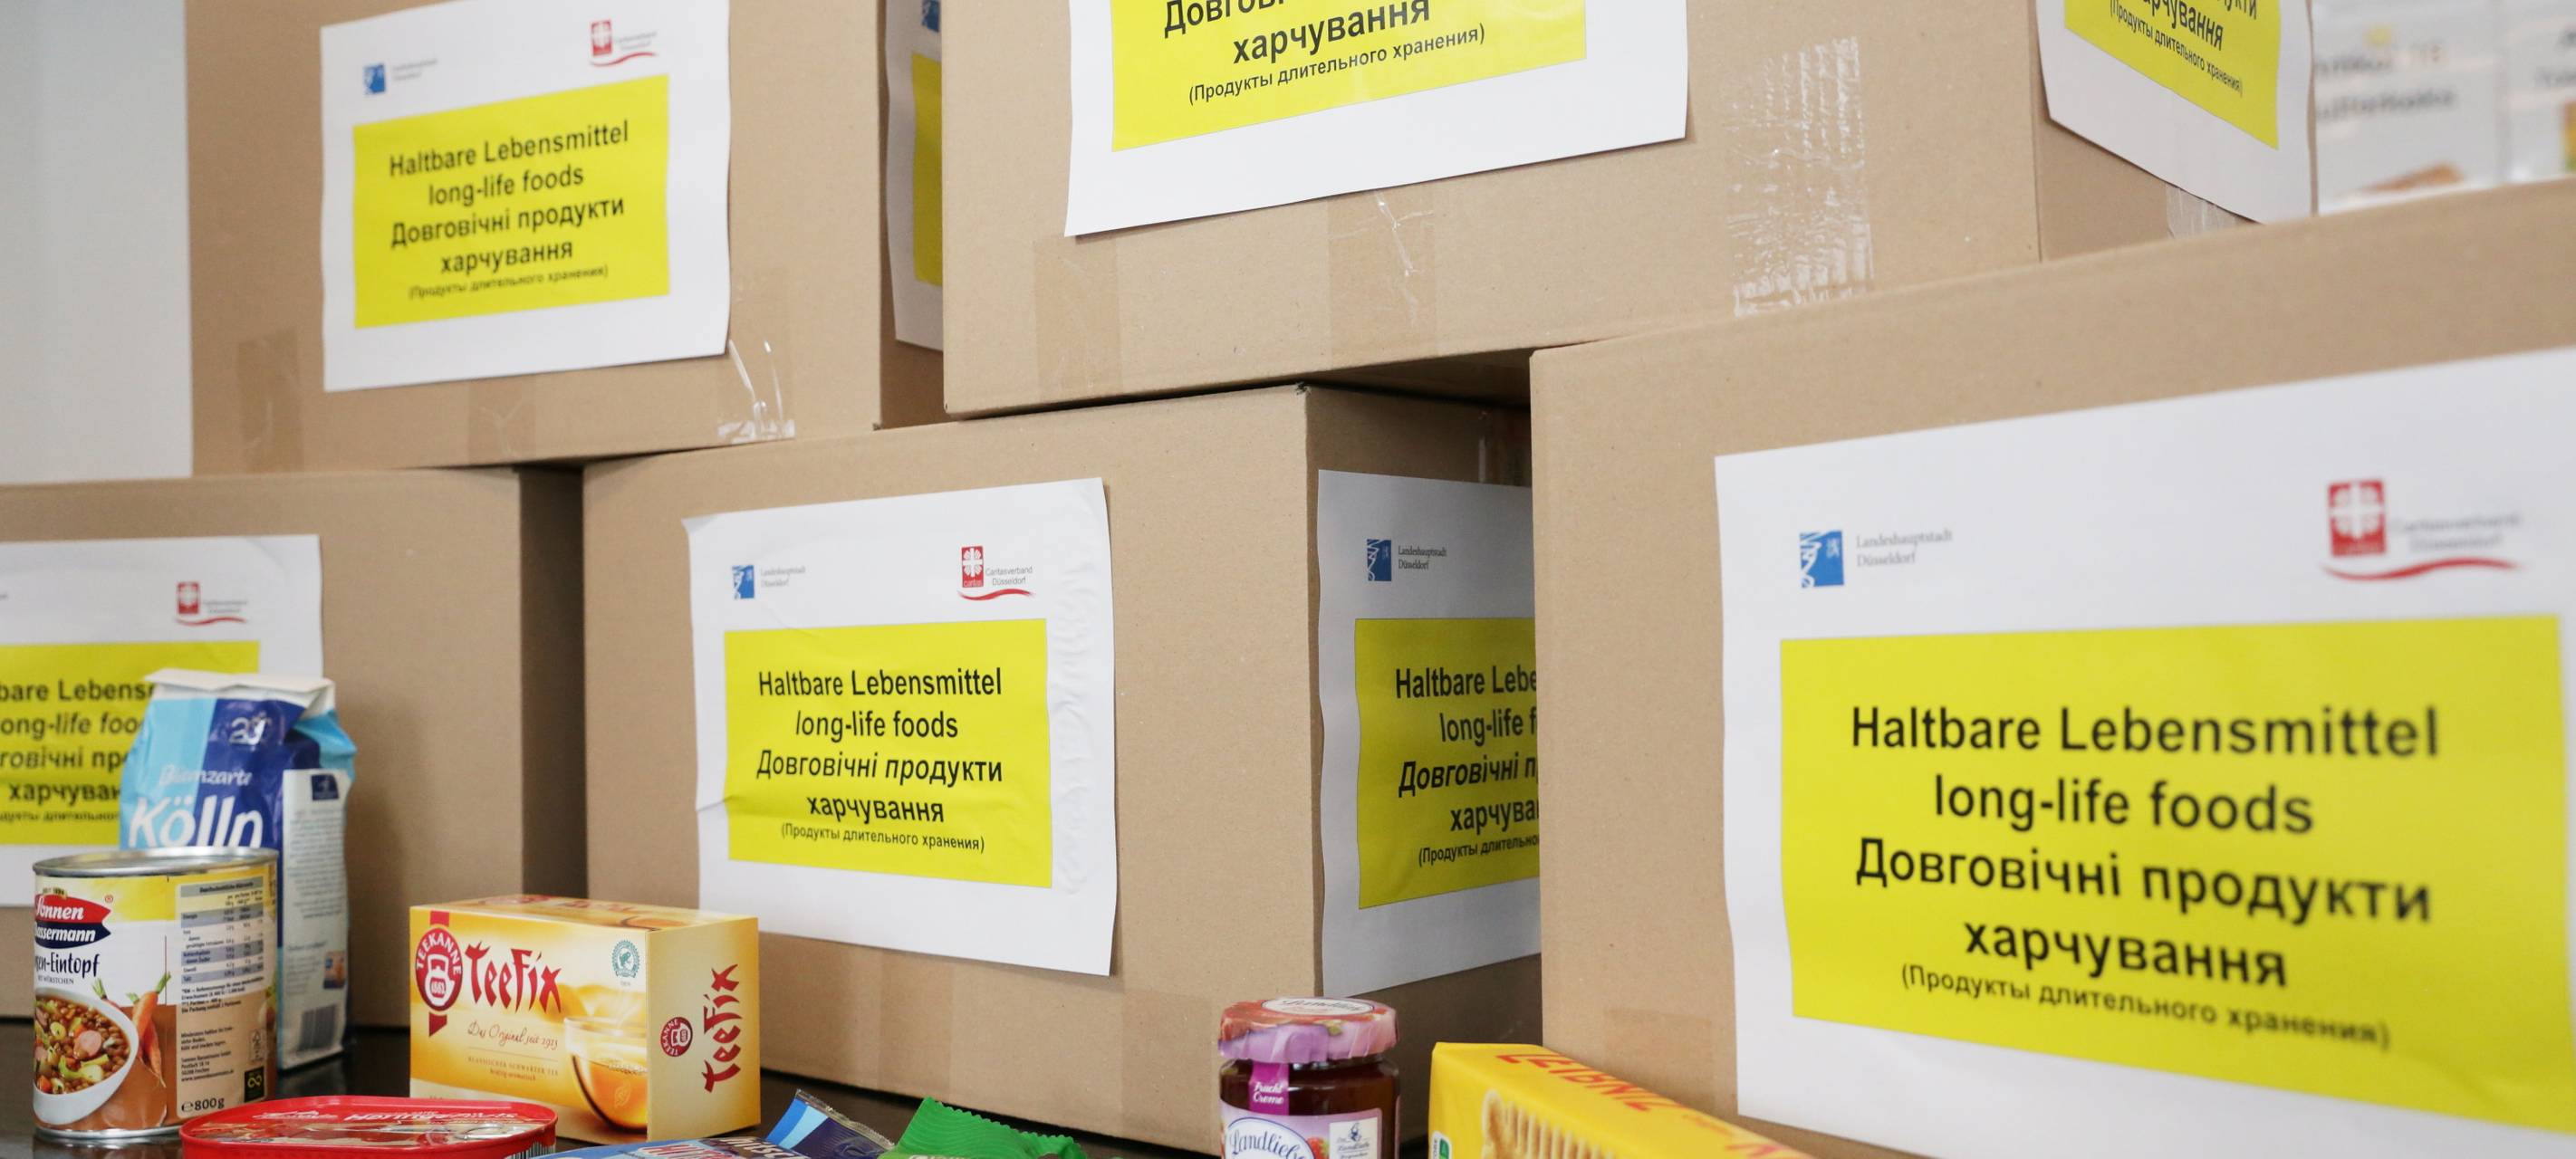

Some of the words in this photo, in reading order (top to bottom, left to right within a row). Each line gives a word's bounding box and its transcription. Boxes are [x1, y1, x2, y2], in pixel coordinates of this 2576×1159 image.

[1233, 0, 1429, 63] харчування
[1188, 73, 1273, 106] (Продукты
[1278, 49, 1387, 86] длительного
[1393, 23, 1485, 60] хранения)
[2155, 30, 2206, 71] длительного
[2206, 62, 2243, 97] хранения)
[389, 147, 476, 177] Haltbare
[485, 120, 629, 162] Lebensmittel
[428, 174, 514, 207] long-life
[523, 164, 584, 191] foods
[390, 210, 510, 249] Довговічні
[518, 198, 624, 232] продукти
[440, 241, 573, 275] харчування
[409, 281, 467, 301] (Продукты
[471, 274, 543, 292] длительного
[985, 566, 1033, 576] Caritasverband
[992, 576, 1026, 587] Düsseldorf
[58, 678, 154, 702] Lebens
[758, 670, 843, 696] Haltbare
[851, 666, 1002, 695] Lebensmittel
[1396, 666, 1485, 699] Haltbare
[101, 712, 143, 733] foo
[795, 710, 886, 743] long-life
[893, 710, 958, 738] foods
[1439, 706, 1524, 747] long-life
[1852, 705, 2042, 751] Haltbare
[2060, 705, 2440, 758] Lebensmittel
[755, 749, 878, 780] Довговічні
[885, 759, 1003, 788] продукти
[1398, 751, 1520, 798] Довговічні
[129, 795, 263, 847] Kölln
[807, 796, 945, 825] харчування
[1935, 773, 2130, 833] long-life
[2148, 779, 2315, 835] foods
[782, 822, 841, 840] (Продукты
[843, 829, 918, 846] длительного
[922, 836, 985, 854] хранения)
[1418, 844, 1478, 867] (Продукты
[1855, 836, 2120, 896] Довговічні
[2141, 866, 2432, 928] продукти
[417, 933, 462, 975] TEEKANNE
[1964, 922, 2288, 989] харчування
[1900, 963, 2031, 1001] (Продукты
[2038, 985, 2218, 1025] длительного
[2227, 1010, 2391, 1050] хранения)
